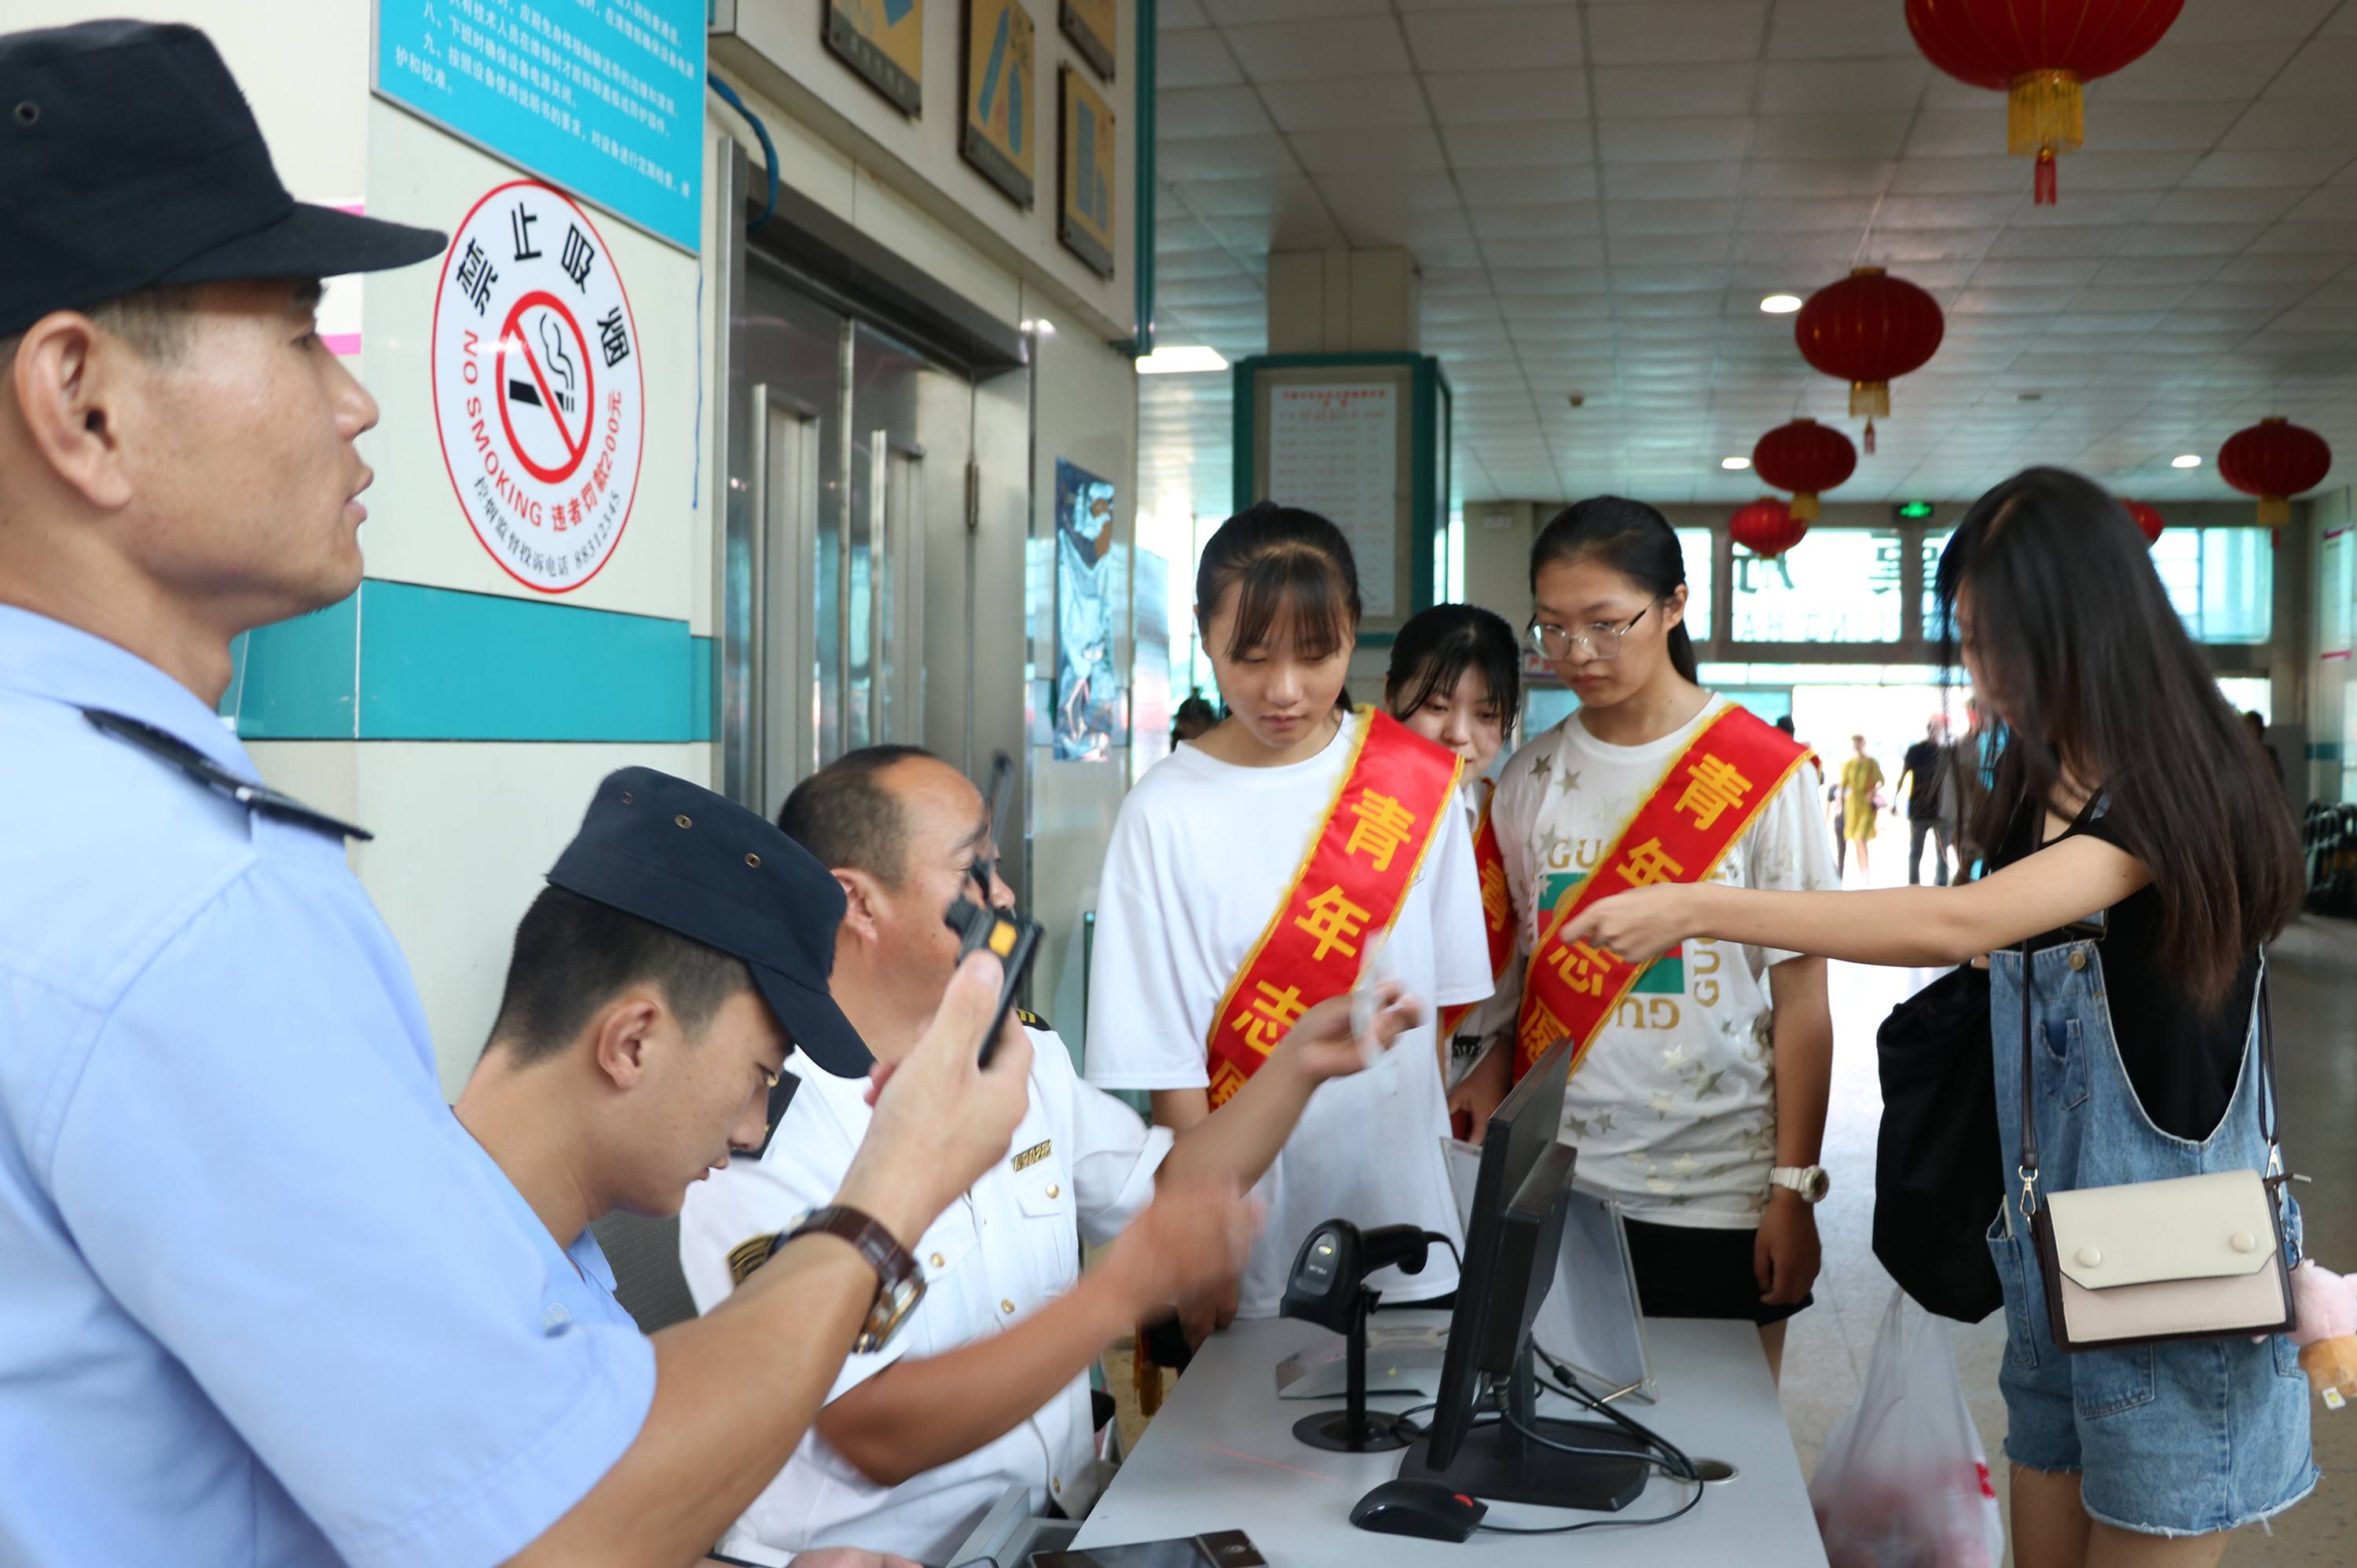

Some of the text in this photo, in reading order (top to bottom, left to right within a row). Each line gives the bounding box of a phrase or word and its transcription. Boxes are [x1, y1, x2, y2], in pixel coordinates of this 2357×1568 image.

[456, 201, 631, 368] 禁止吸烟
[463, 329, 543, 529] NO SMOKING
[552, 390, 622, 533] 违者罚款200元
[1547, 838, 1611, 870] GU
